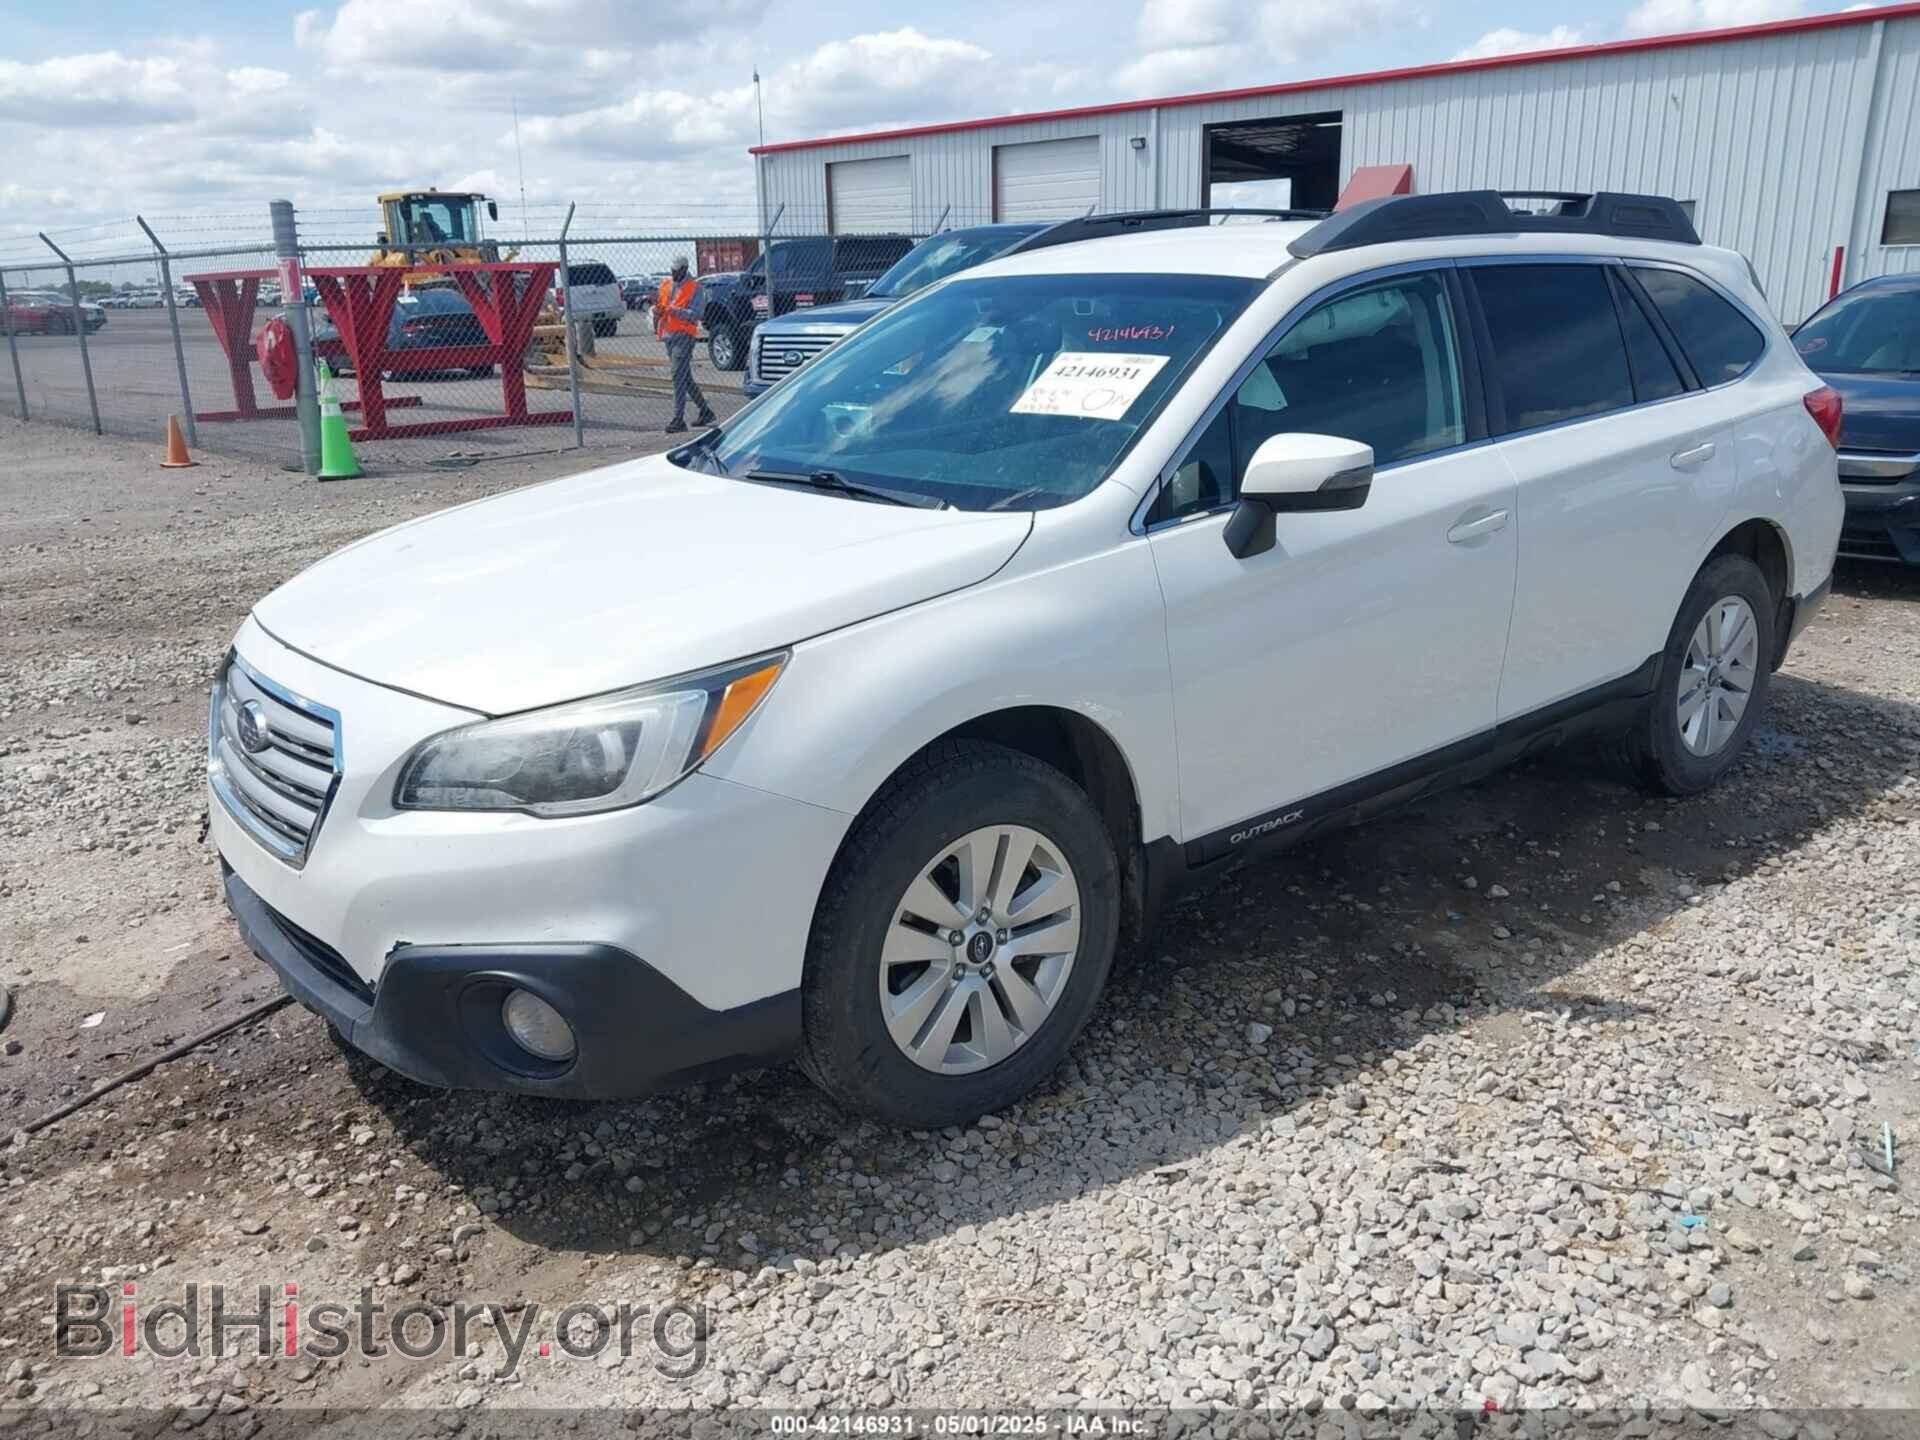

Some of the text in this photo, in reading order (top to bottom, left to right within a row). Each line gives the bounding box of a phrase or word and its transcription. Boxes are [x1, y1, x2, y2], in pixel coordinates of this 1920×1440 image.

[1087, 324, 1175, 342] 42146931
[1054, 364, 1142, 380] 42146931
[1229, 808, 1305, 845] OUTBACK
